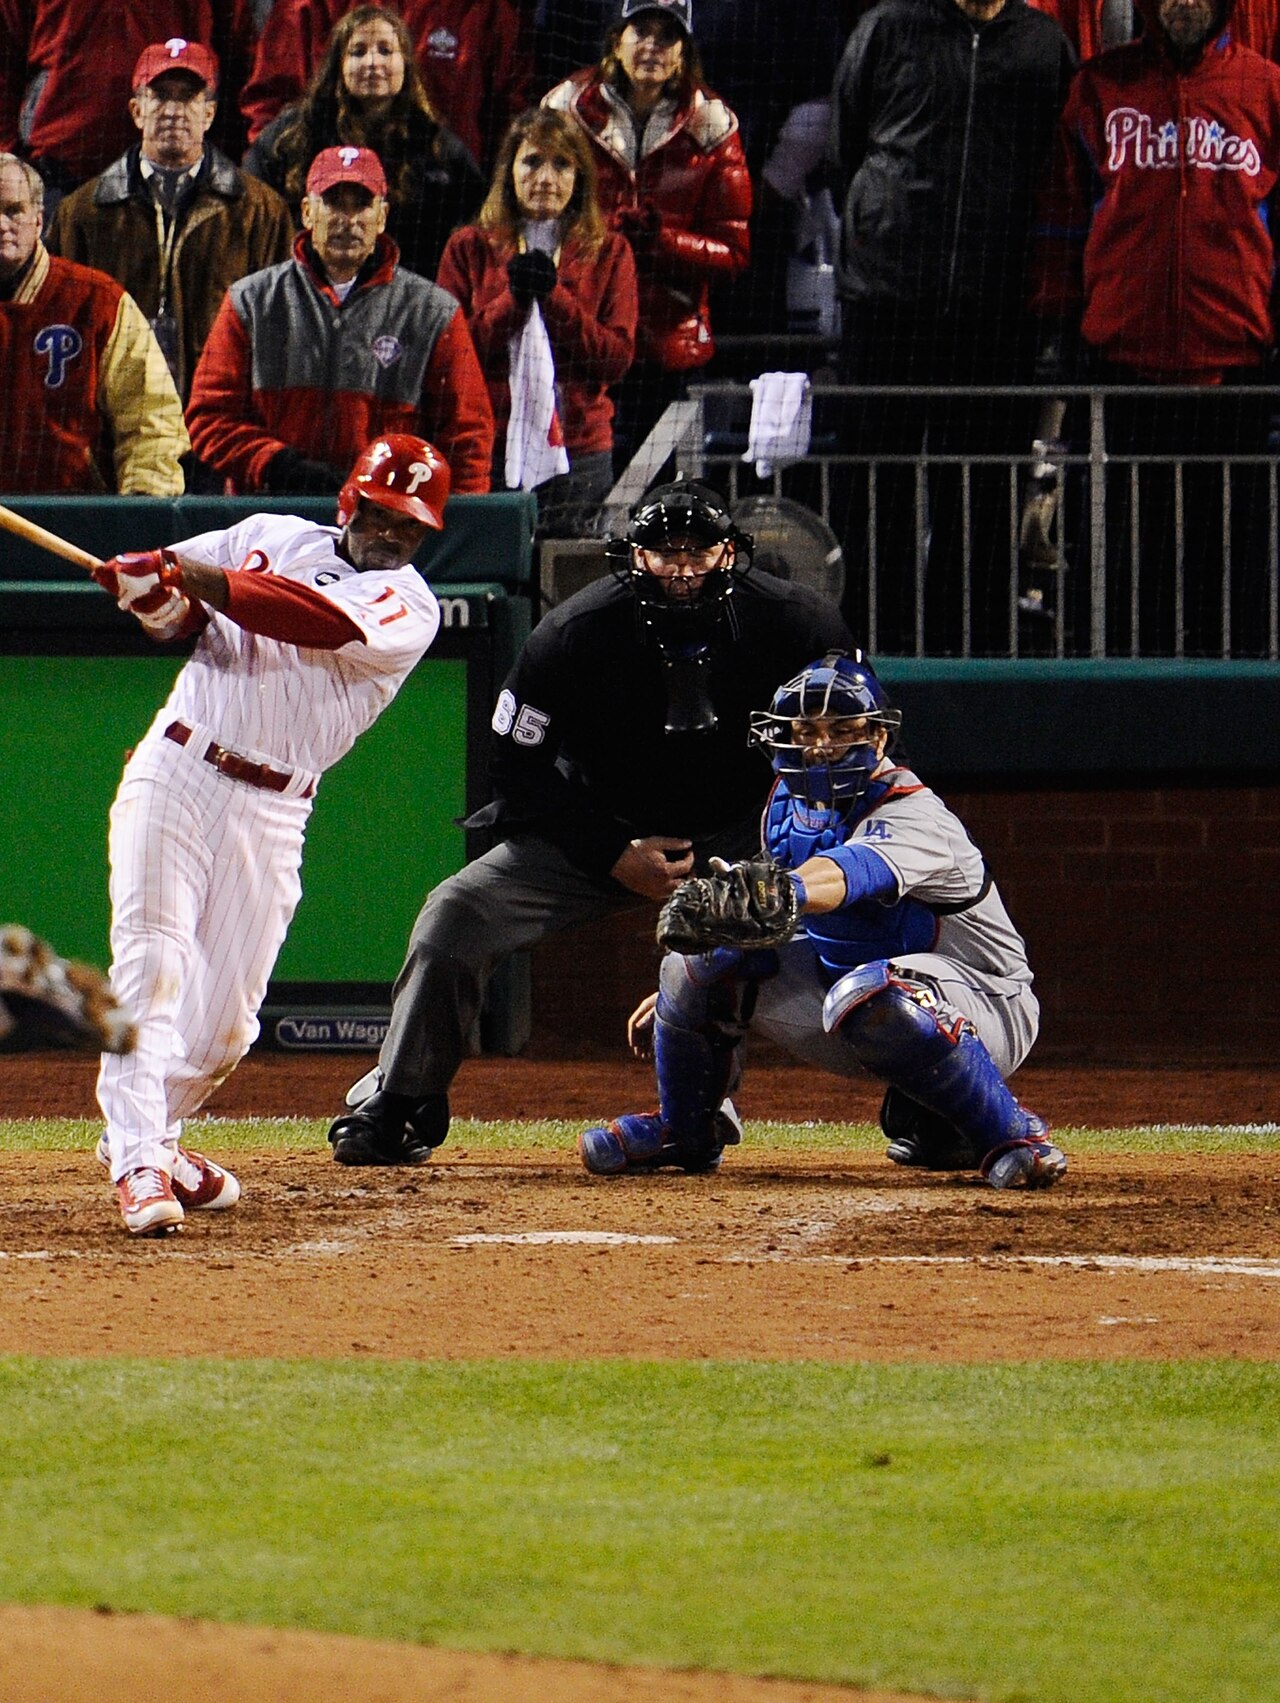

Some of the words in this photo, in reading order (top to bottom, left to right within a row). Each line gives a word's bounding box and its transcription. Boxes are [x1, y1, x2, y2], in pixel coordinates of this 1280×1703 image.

[1105, 107, 1261, 177] Phillies
[34, 324, 82, 388] P
[406, 462, 432, 494] P
[492, 689, 551, 747] 65
[288, 1021, 331, 1039] Van
